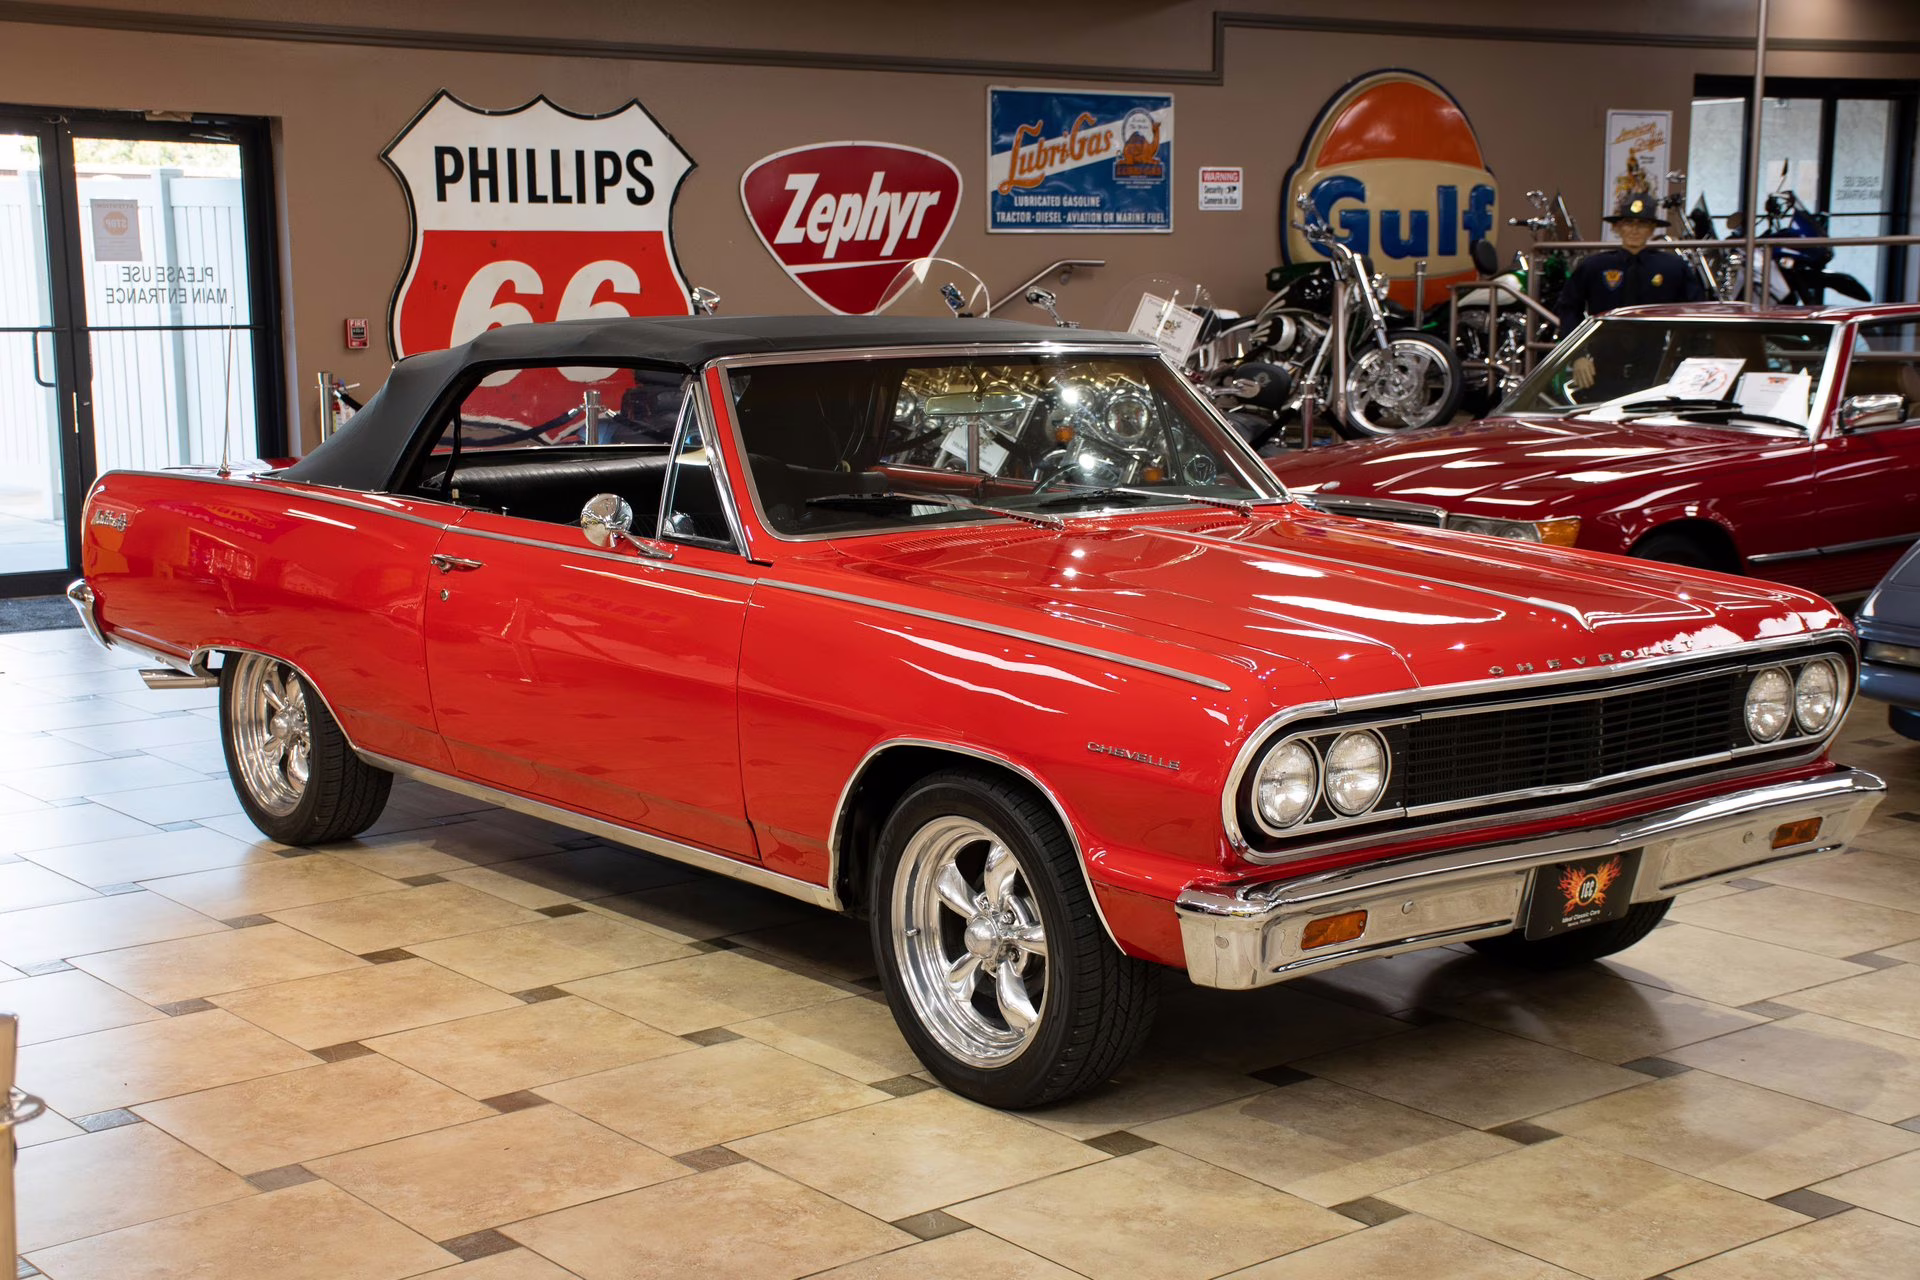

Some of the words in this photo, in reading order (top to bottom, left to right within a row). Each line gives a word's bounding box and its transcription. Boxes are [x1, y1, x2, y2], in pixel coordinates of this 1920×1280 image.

[434, 145, 655, 206] PHILLIPS
[1203, 171, 1239, 182] WARNING
[773, 171, 941, 259] Zephyr
[996, 211, 1032, 223] TRACTOR
[1035, 211, 1063, 223] DIESEL
[1066, 211, 1102, 223] AVIATION
[1103, 213, 1115, 223] OR
[1116, 212, 1146, 224] MARINE
[1146, 212, 1166, 224] FUEL
[1013, 195, 1060, 207] LUBRICATED
[1062, 196, 1101, 207] GASOLINE
[1303, 175, 1495, 260] Gulf
[350, 319, 367, 327] FIRE
[449, 259, 642, 388] 66
[1488, 640, 1693, 676] CHEVROLET
[1087, 741, 1181, 771] CHEVELLE
